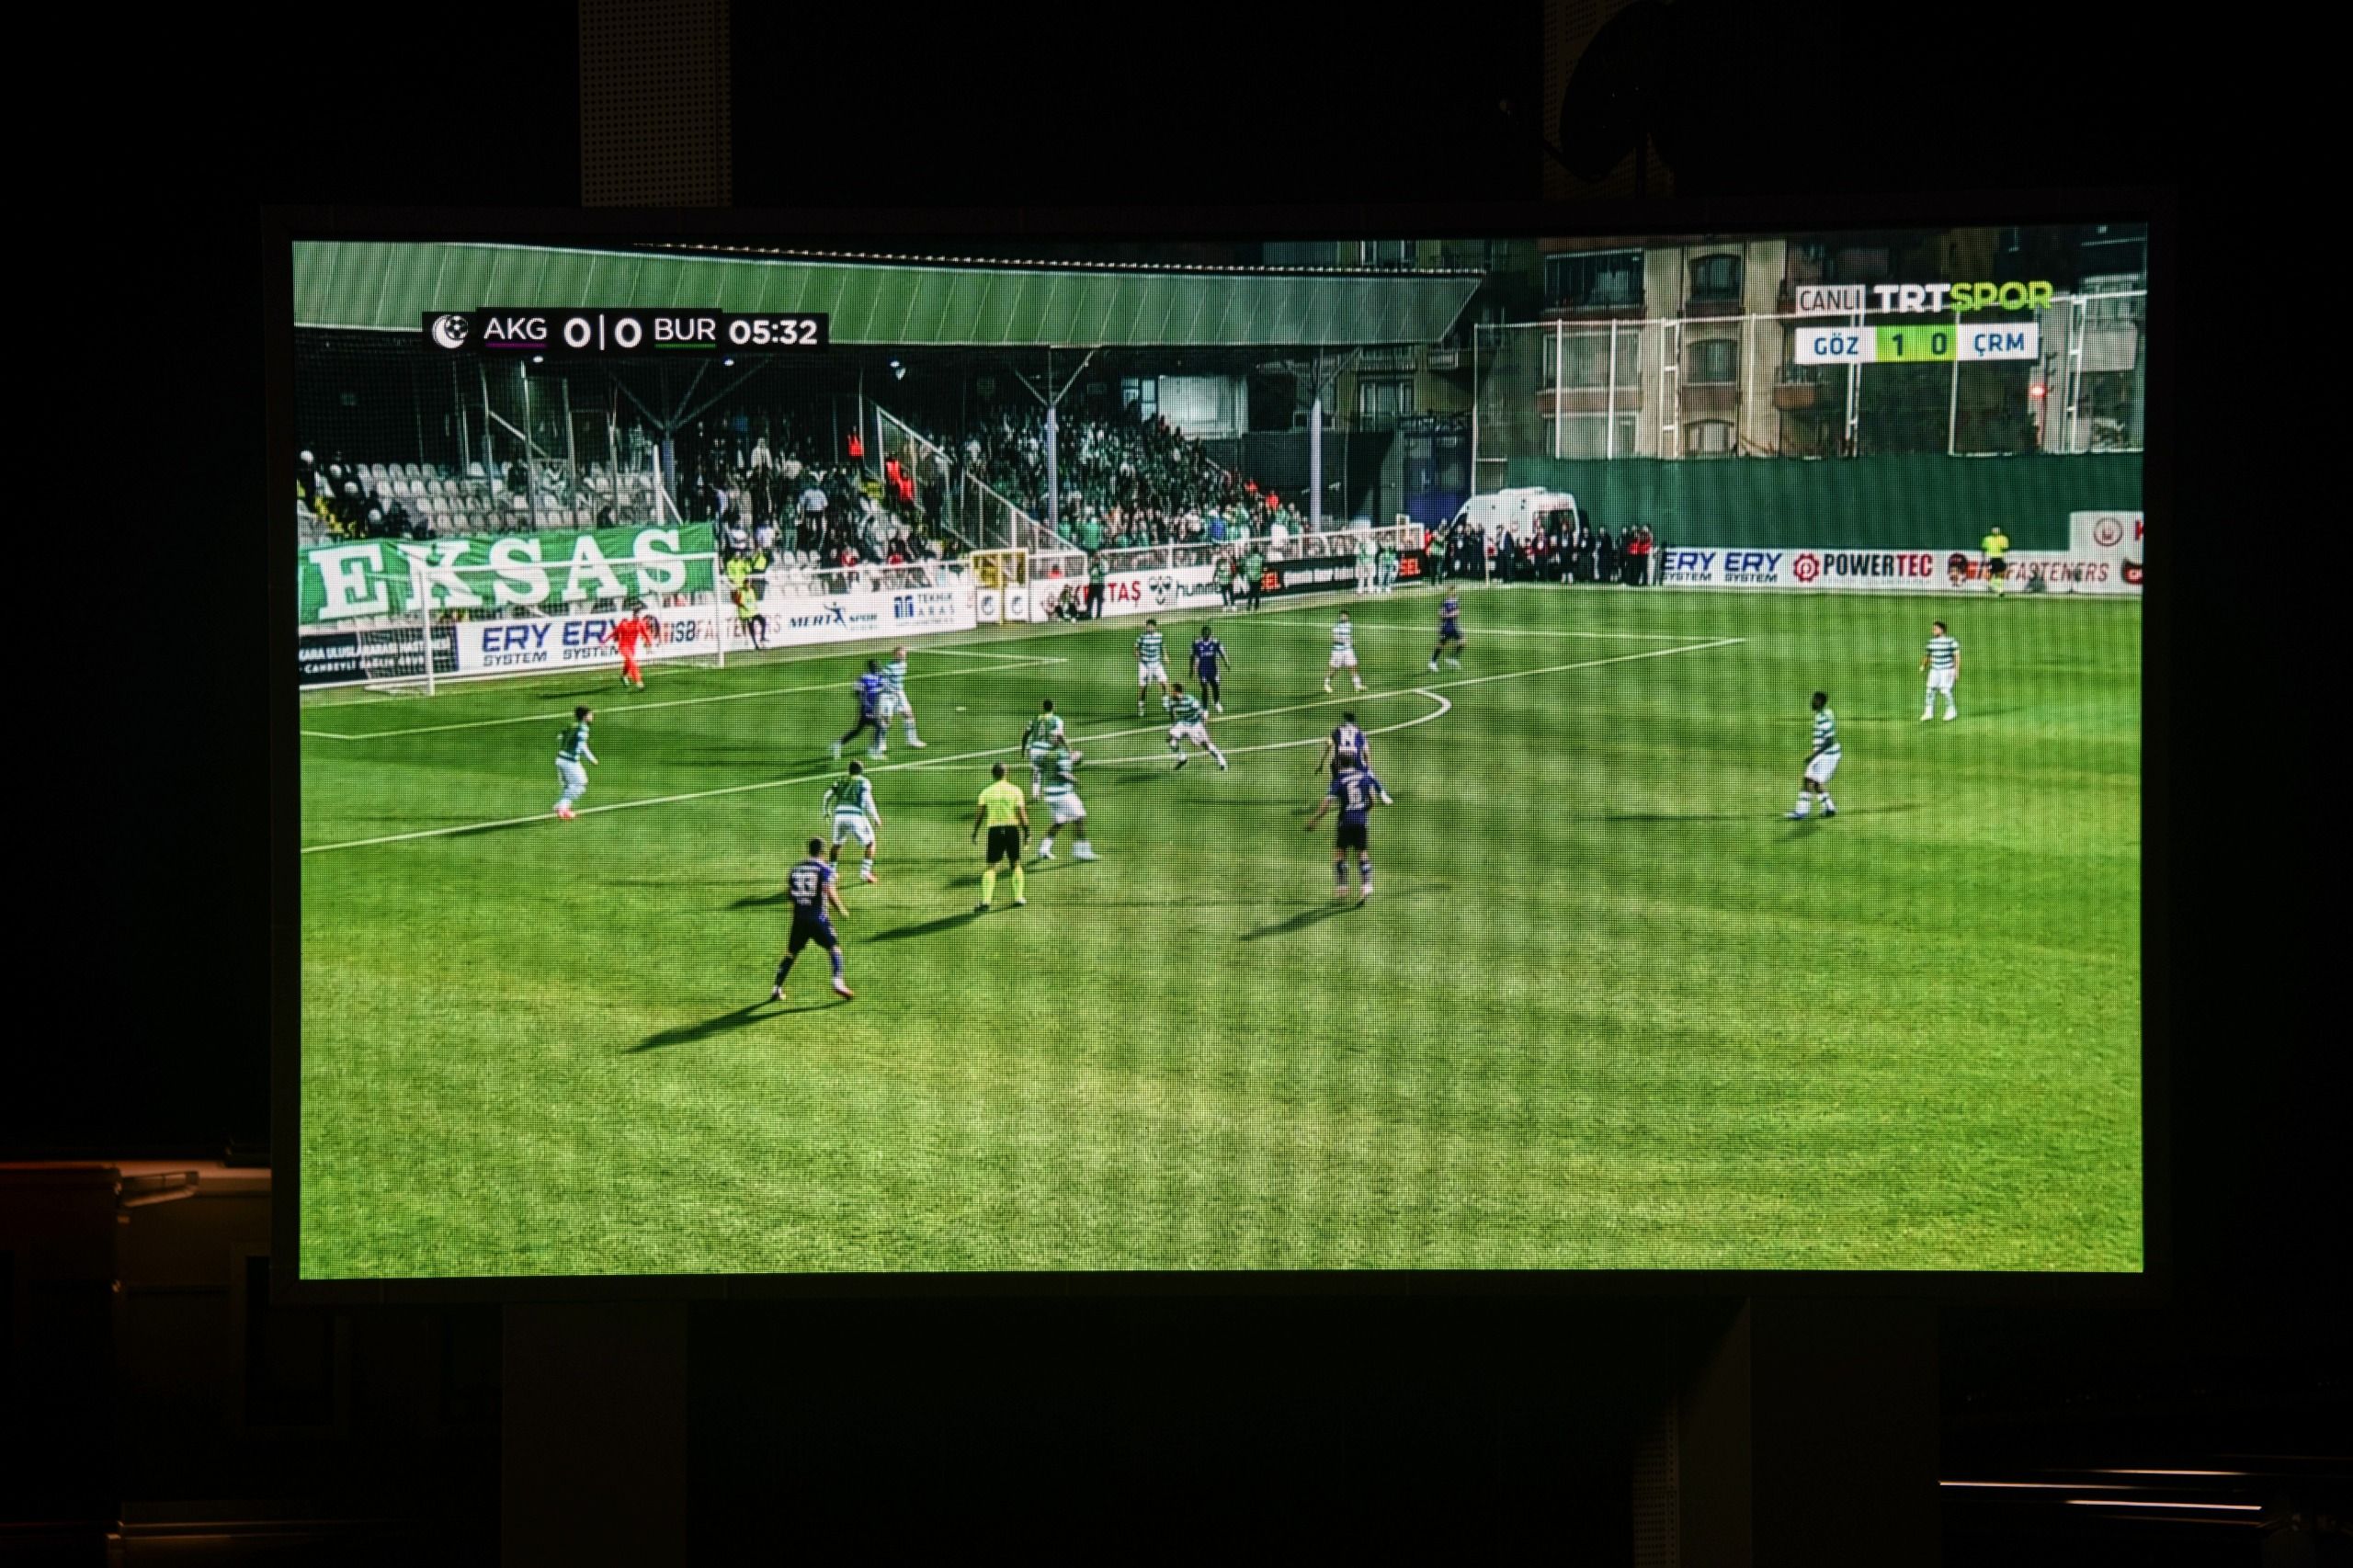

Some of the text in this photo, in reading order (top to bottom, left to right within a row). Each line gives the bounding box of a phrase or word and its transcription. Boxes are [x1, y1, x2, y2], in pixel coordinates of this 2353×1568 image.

[1800, 290, 1860, 311] CANLI
[483, 317, 547, 340] AKG
[654, 317, 717, 341] BUR
[728, 320, 818, 345] 05:32
[1813, 332, 2025, 357] GÖZ 1 0 ÇRM
[1725, 551, 1782, 572] ERY
[1823, 553, 1933, 577] POWERTEC
[1725, 573, 1779, 583] SYSTEM
[482, 622, 552, 653] ERY
[483, 651, 548, 667] SYSTEM
[790, 871, 818, 897] 33
